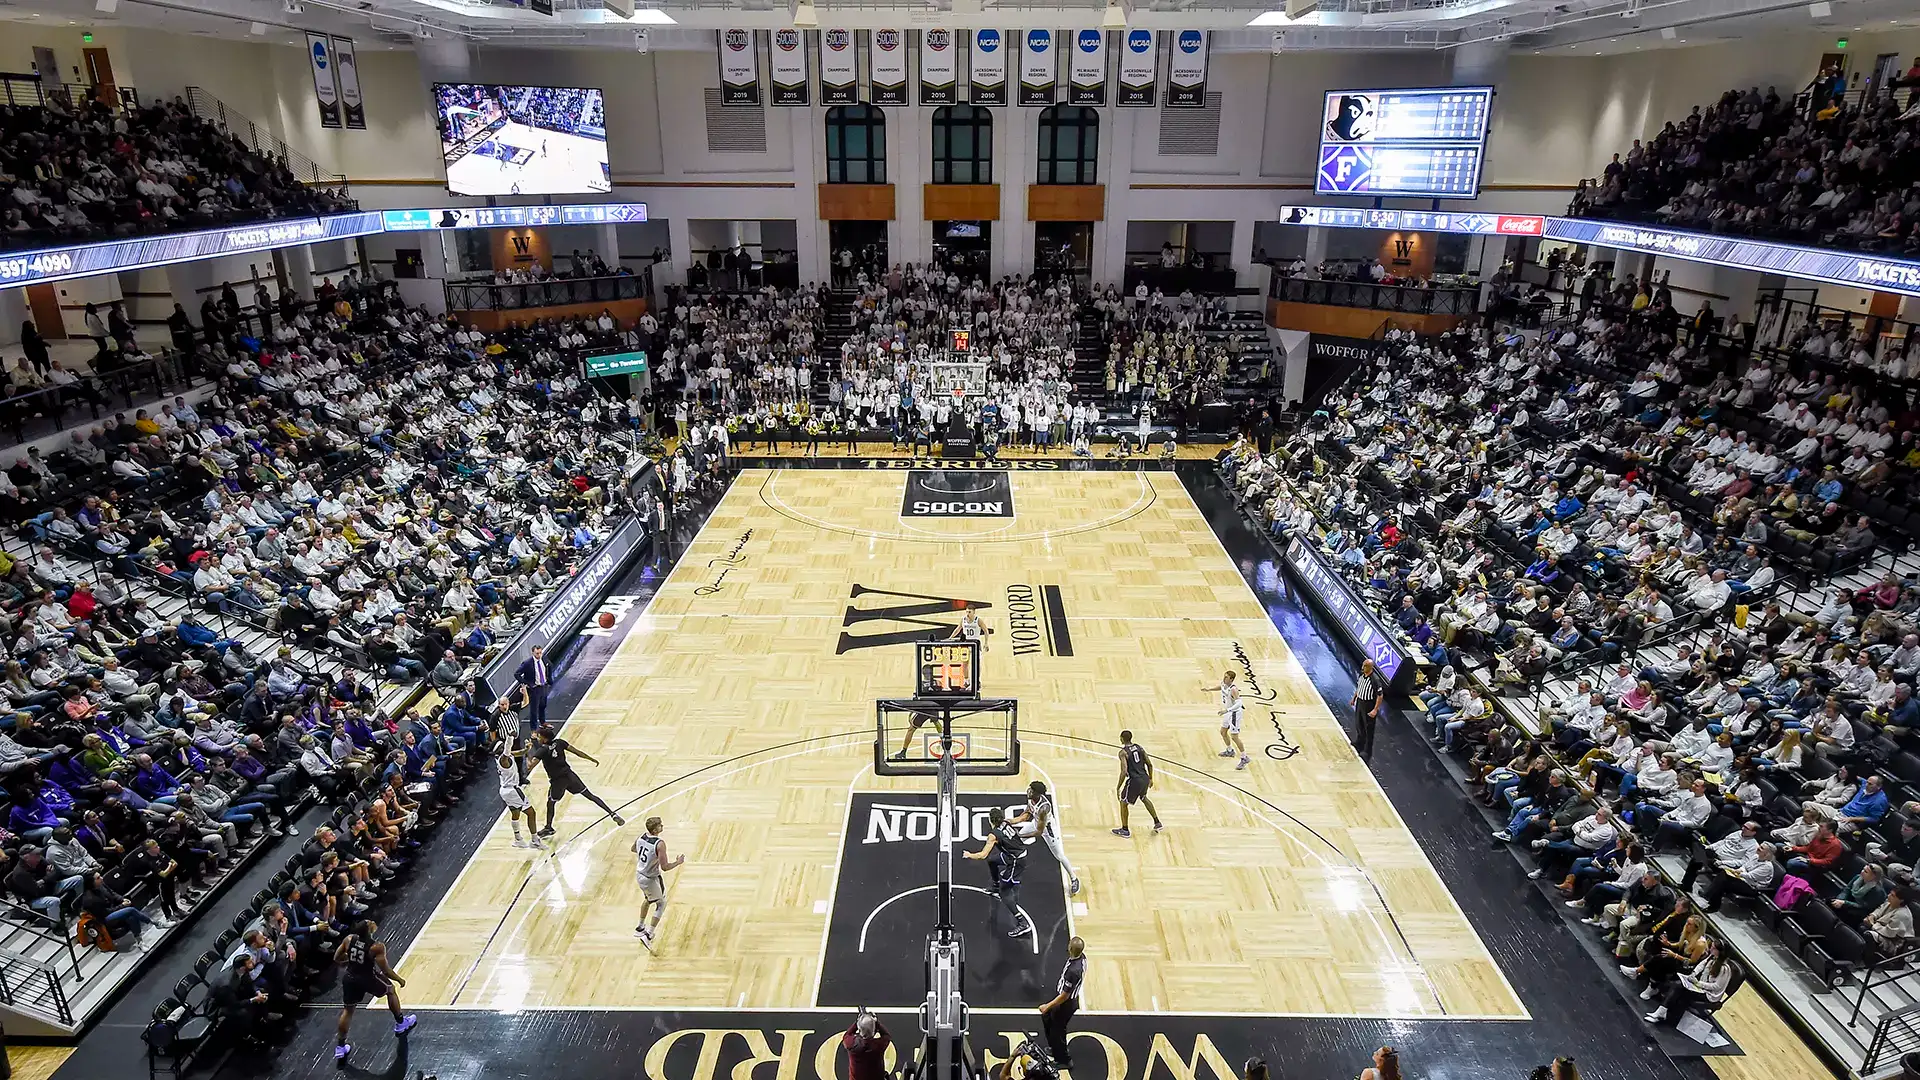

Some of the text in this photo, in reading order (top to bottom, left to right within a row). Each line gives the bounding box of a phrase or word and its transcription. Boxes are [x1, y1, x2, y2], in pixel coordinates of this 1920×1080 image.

[979, 39, 999, 47] NCAA
[1029, 39, 1051, 47] NCAA
[1079, 39, 1100, 47] NCAA
[1130, 39, 1151, 47] NCAA
[1180, 40, 1201, 48] NCAA
[1502, 218, 1539, 233] Coca-Cola
[511, 236, 531, 254] W
[1394, 239, 1414, 258] W
[1315, 342, 1375, 360] WOFFOR
[860, 459, 1059, 470] TERRIERS
[912, 501, 1004, 515] SOCON
[538, 552, 614, 640] TICKETS: 864-597-4090
[835, 583, 995, 656] W
[1006, 583, 1043, 656] WOFFORD
[966, 628, 975, 637] 10
[638, 845, 650, 864] 15
[349, 949, 366, 965] 23
